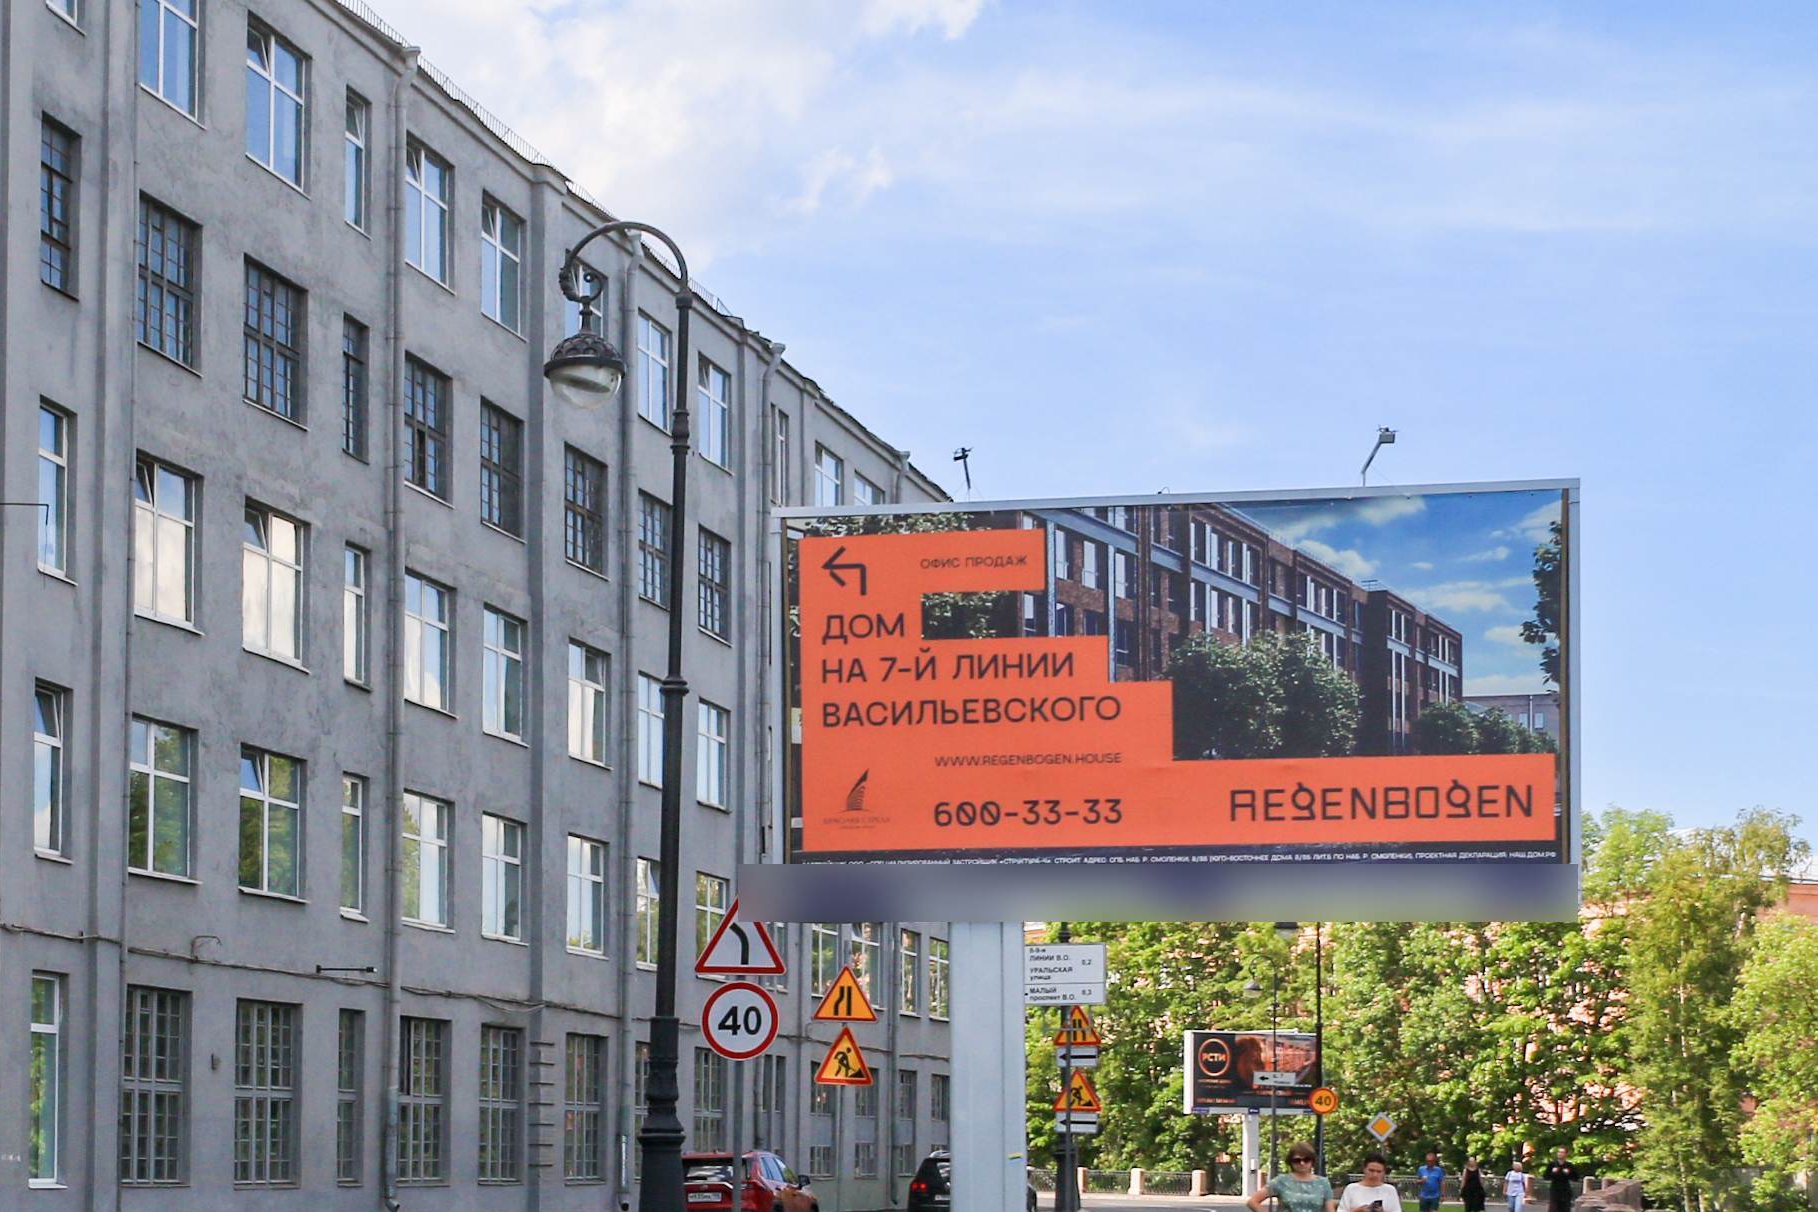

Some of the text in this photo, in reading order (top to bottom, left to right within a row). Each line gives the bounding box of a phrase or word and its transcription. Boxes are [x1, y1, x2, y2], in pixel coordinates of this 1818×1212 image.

[920, 554, 1028, 569] ОФИС ПРОДАЖ
[822, 612, 905, 645] ДОМ
[822, 646, 1074, 684] НА 7-Й ЛИНИИ
[822, 695, 1122, 728] ВАСИЛЬЕВСКОГО
[934, 752, 1122, 768] WWW.REGENBOGEN.HOUSE
[933, 798, 1123, 827] 600-33-33
[1229, 779, 1533, 822] REGENBOGEN
[1029, 966, 1074, 974] УРАЛЬСКАЯ
[1029, 986, 1057, 994] МАЛЫЙ
[718, 1006, 762, 1036] 40
[1314, 1095, 1332, 1107] 40
